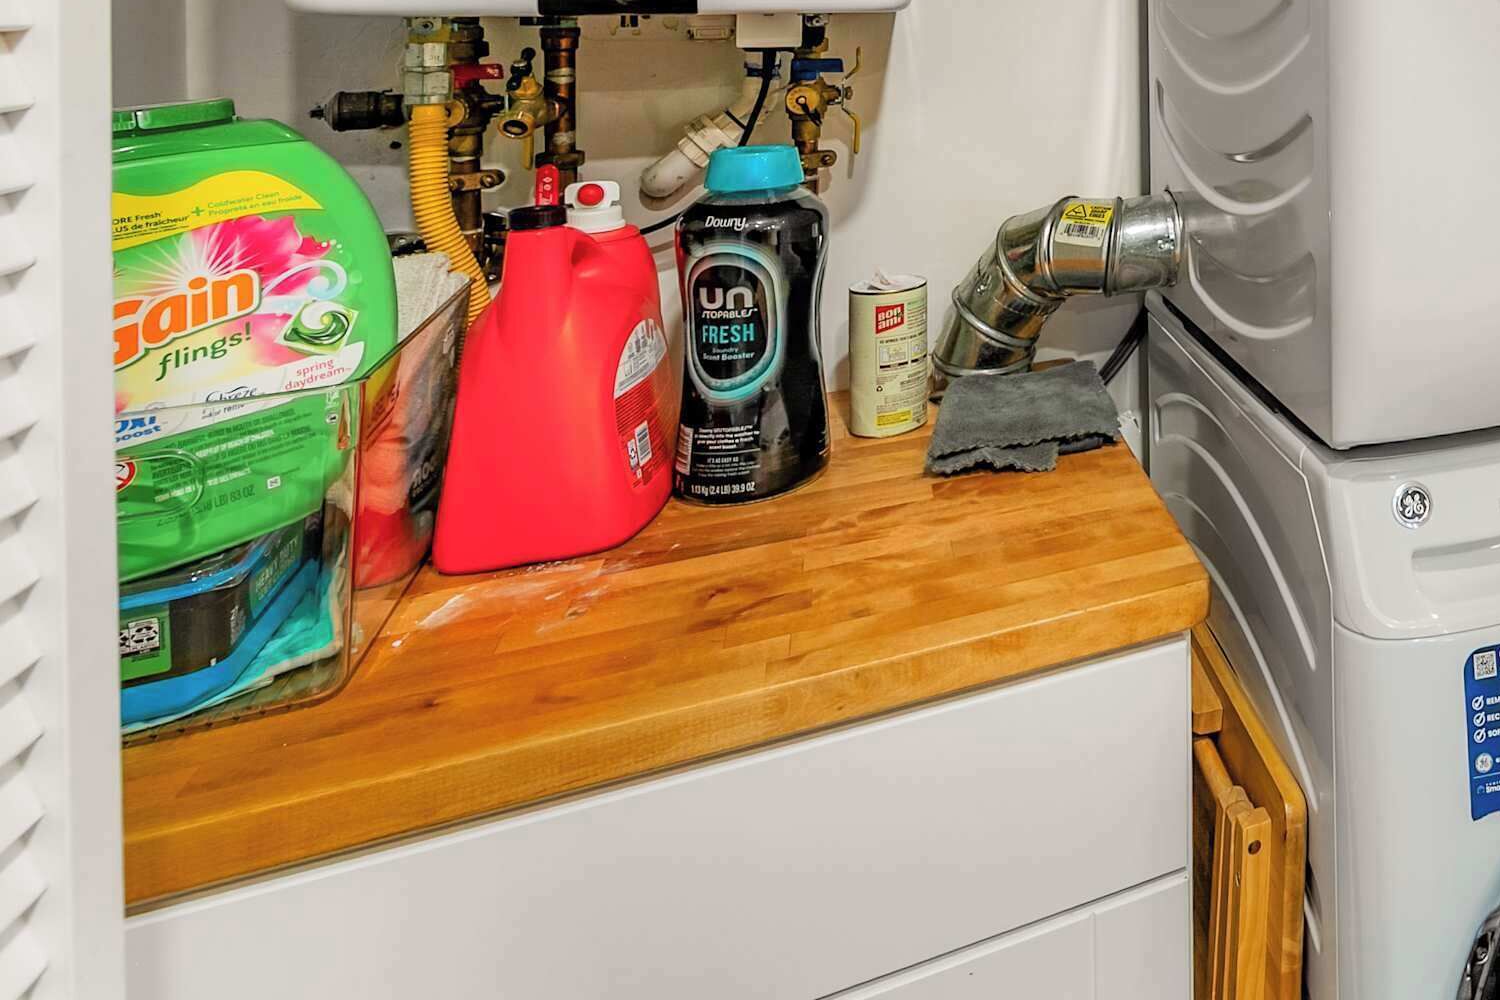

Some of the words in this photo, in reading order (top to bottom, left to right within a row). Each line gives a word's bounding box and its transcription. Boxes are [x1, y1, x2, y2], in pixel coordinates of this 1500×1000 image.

[112, 216, 131, 226] ORE
[131, 222, 144, 231] de
[705, 215, 749, 231] Downy
[702, 323, 755, 344] FRESH
[155, 322, 253, 382] flings!
[296, 357, 334, 377] spring
[285, 367, 346, 391] daydream
